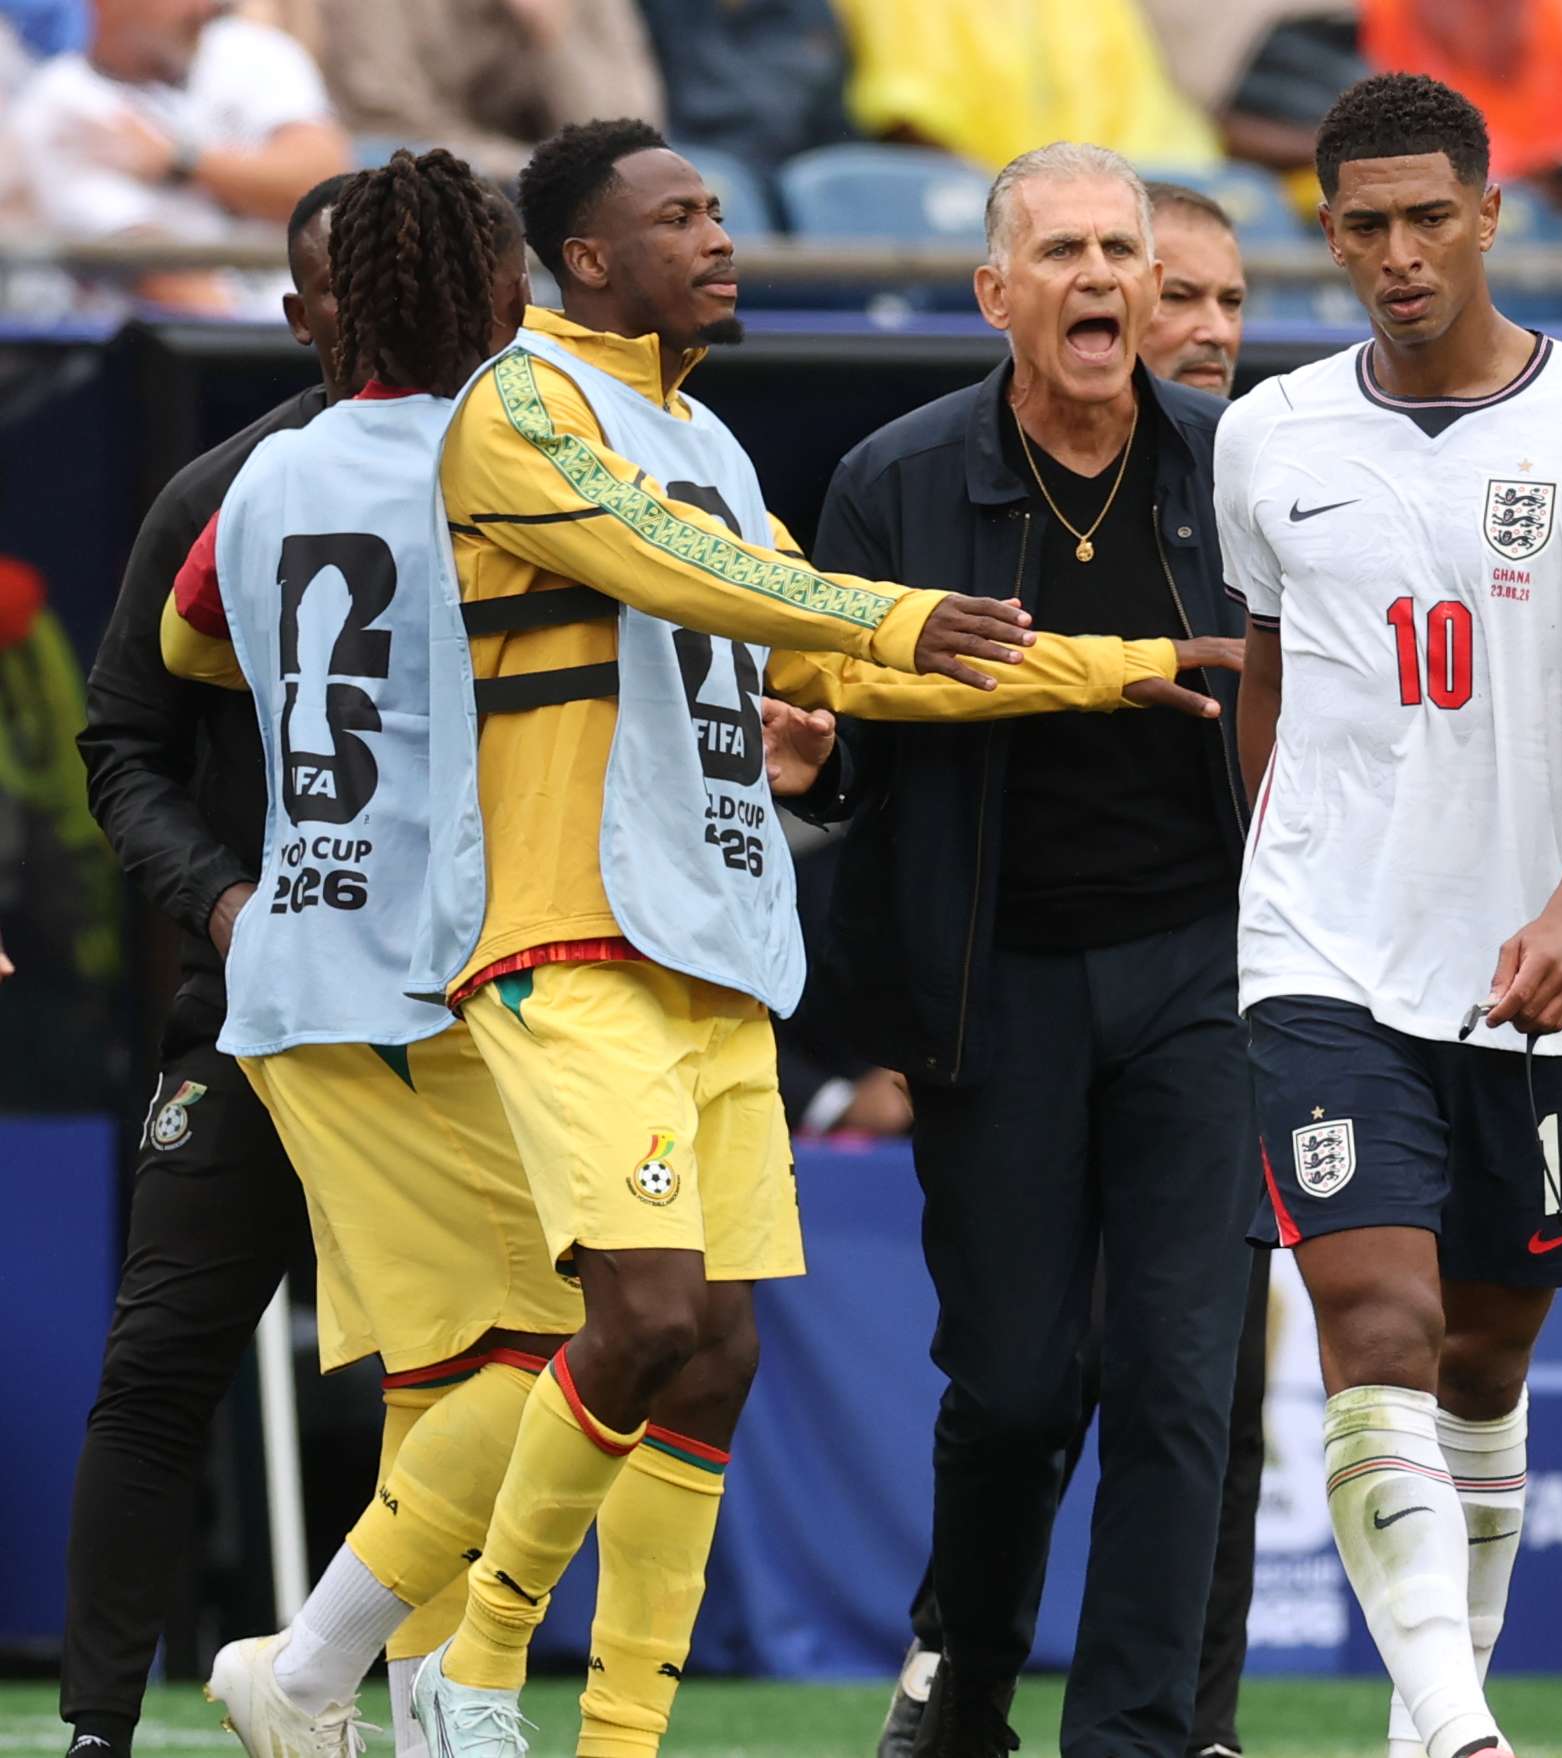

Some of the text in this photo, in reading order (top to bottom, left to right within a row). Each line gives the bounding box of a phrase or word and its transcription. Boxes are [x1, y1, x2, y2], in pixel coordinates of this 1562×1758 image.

[1493, 568, 1530, 584] GHANA
[1386, 596, 1473, 710] 10
[291, 766, 337, 799] FA
[737, 800, 765, 830] CUP
[311, 836, 373, 864] CUP
